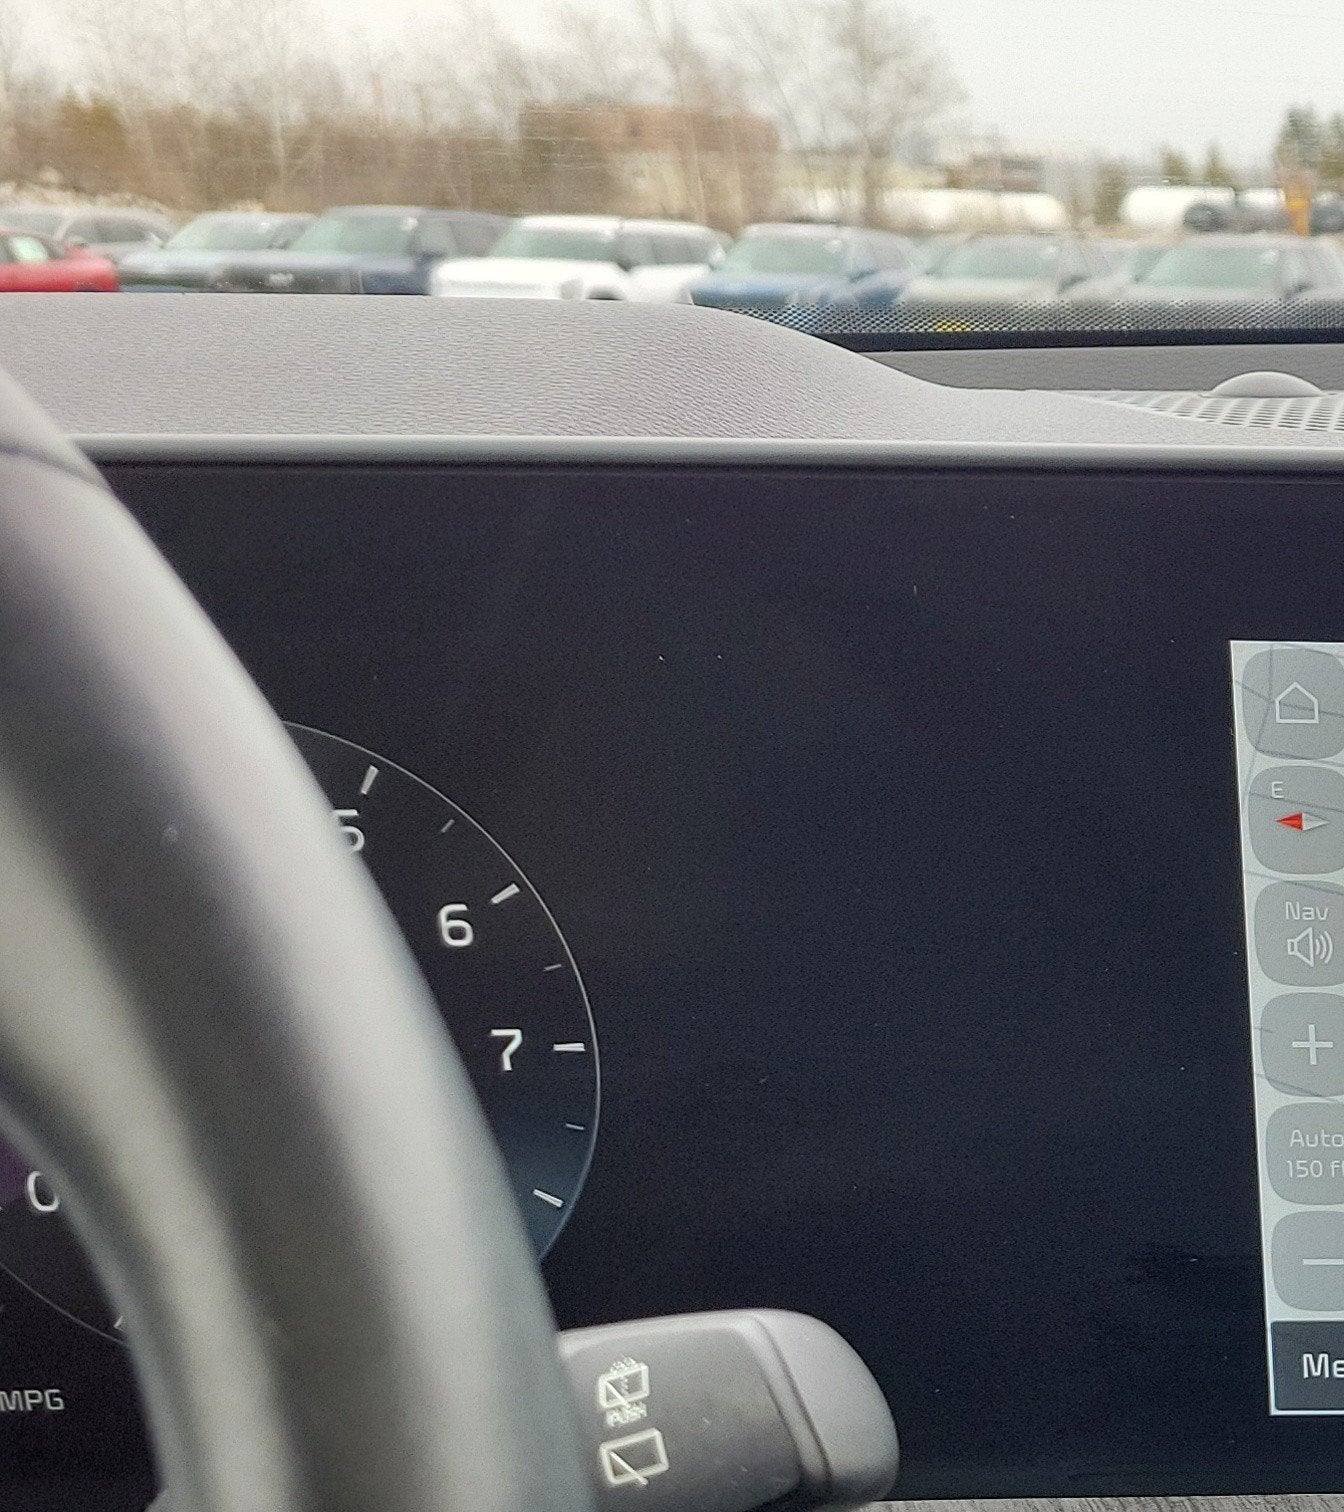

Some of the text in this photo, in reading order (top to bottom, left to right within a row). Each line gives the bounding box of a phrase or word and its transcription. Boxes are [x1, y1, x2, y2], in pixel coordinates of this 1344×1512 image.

[1271, 781, 1284, 799] E
[334, 809, 365, 853] 5
[1284, 902, 1329, 921] Nav
[437, 904, 475, 948] 6
[490, 1028, 524, 1072] 7
[1289, 1129, 1344, 1148] Auto
[1286, 1159, 1324, 1178] 150
[0, 1388, 65, 1412] MPG
